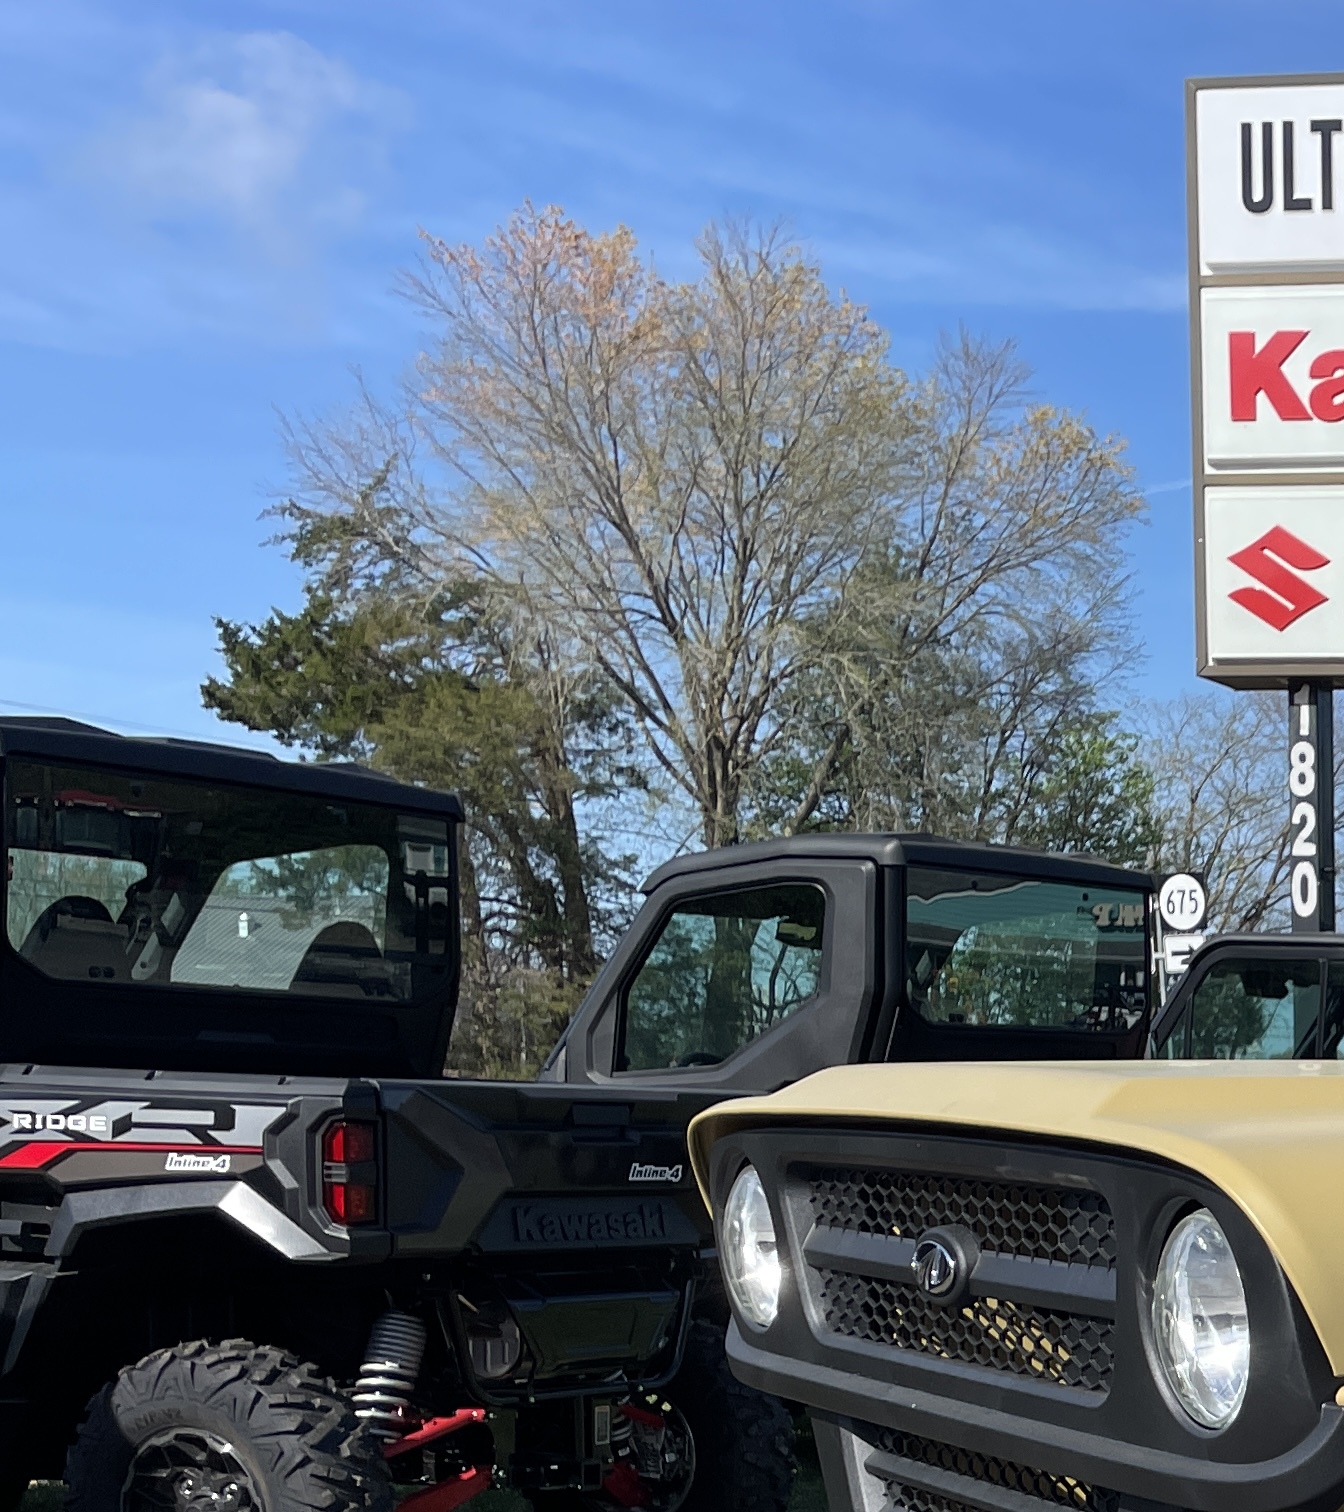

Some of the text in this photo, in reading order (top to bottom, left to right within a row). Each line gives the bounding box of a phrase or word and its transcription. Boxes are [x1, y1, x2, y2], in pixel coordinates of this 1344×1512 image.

[1289, 684, 1318, 918] 1820
[1166, 889, 1198, 915] 675
[12, 1112, 108, 1132] RIDGE
[512, 1202, 667, 1242] Kawasaki
